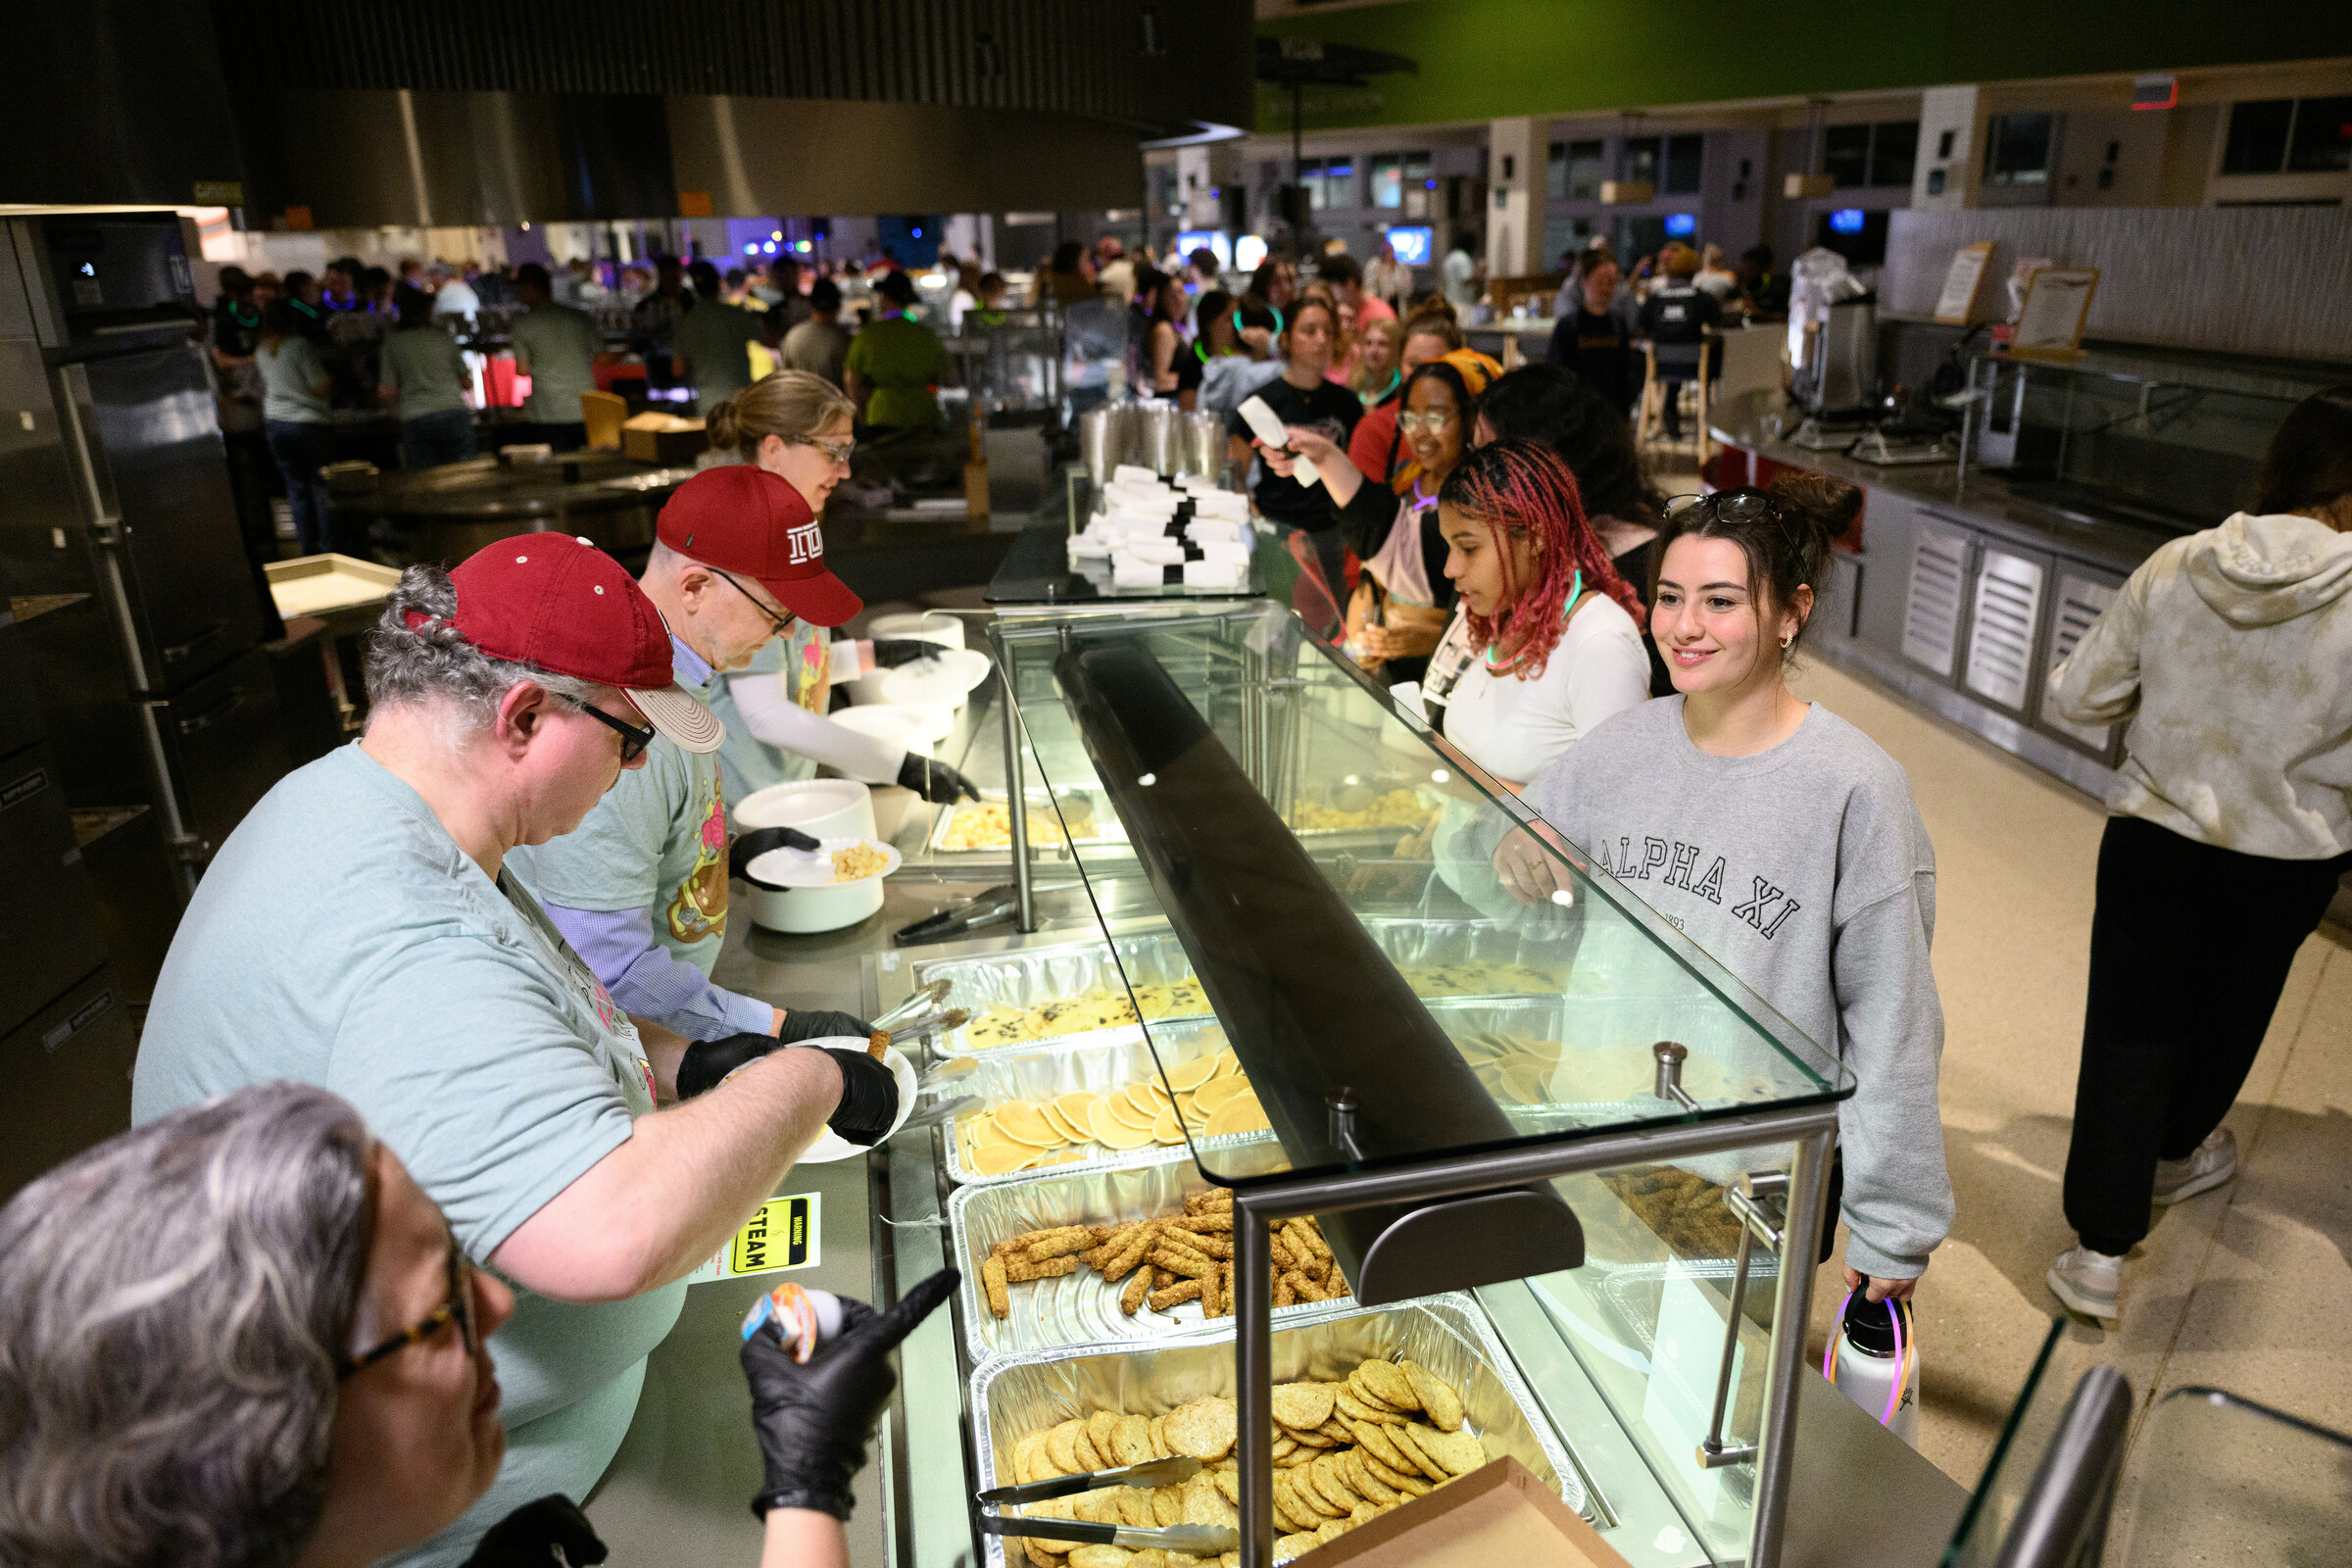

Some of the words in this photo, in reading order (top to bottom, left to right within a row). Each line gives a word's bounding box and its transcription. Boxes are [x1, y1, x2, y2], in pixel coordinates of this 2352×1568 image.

[1598, 836, 1727, 906] ALPHA
[1732, 875, 1801, 941] XI
[746, 1206, 768, 1268] STEAM
[793, 1216, 803, 1246] WARNING
